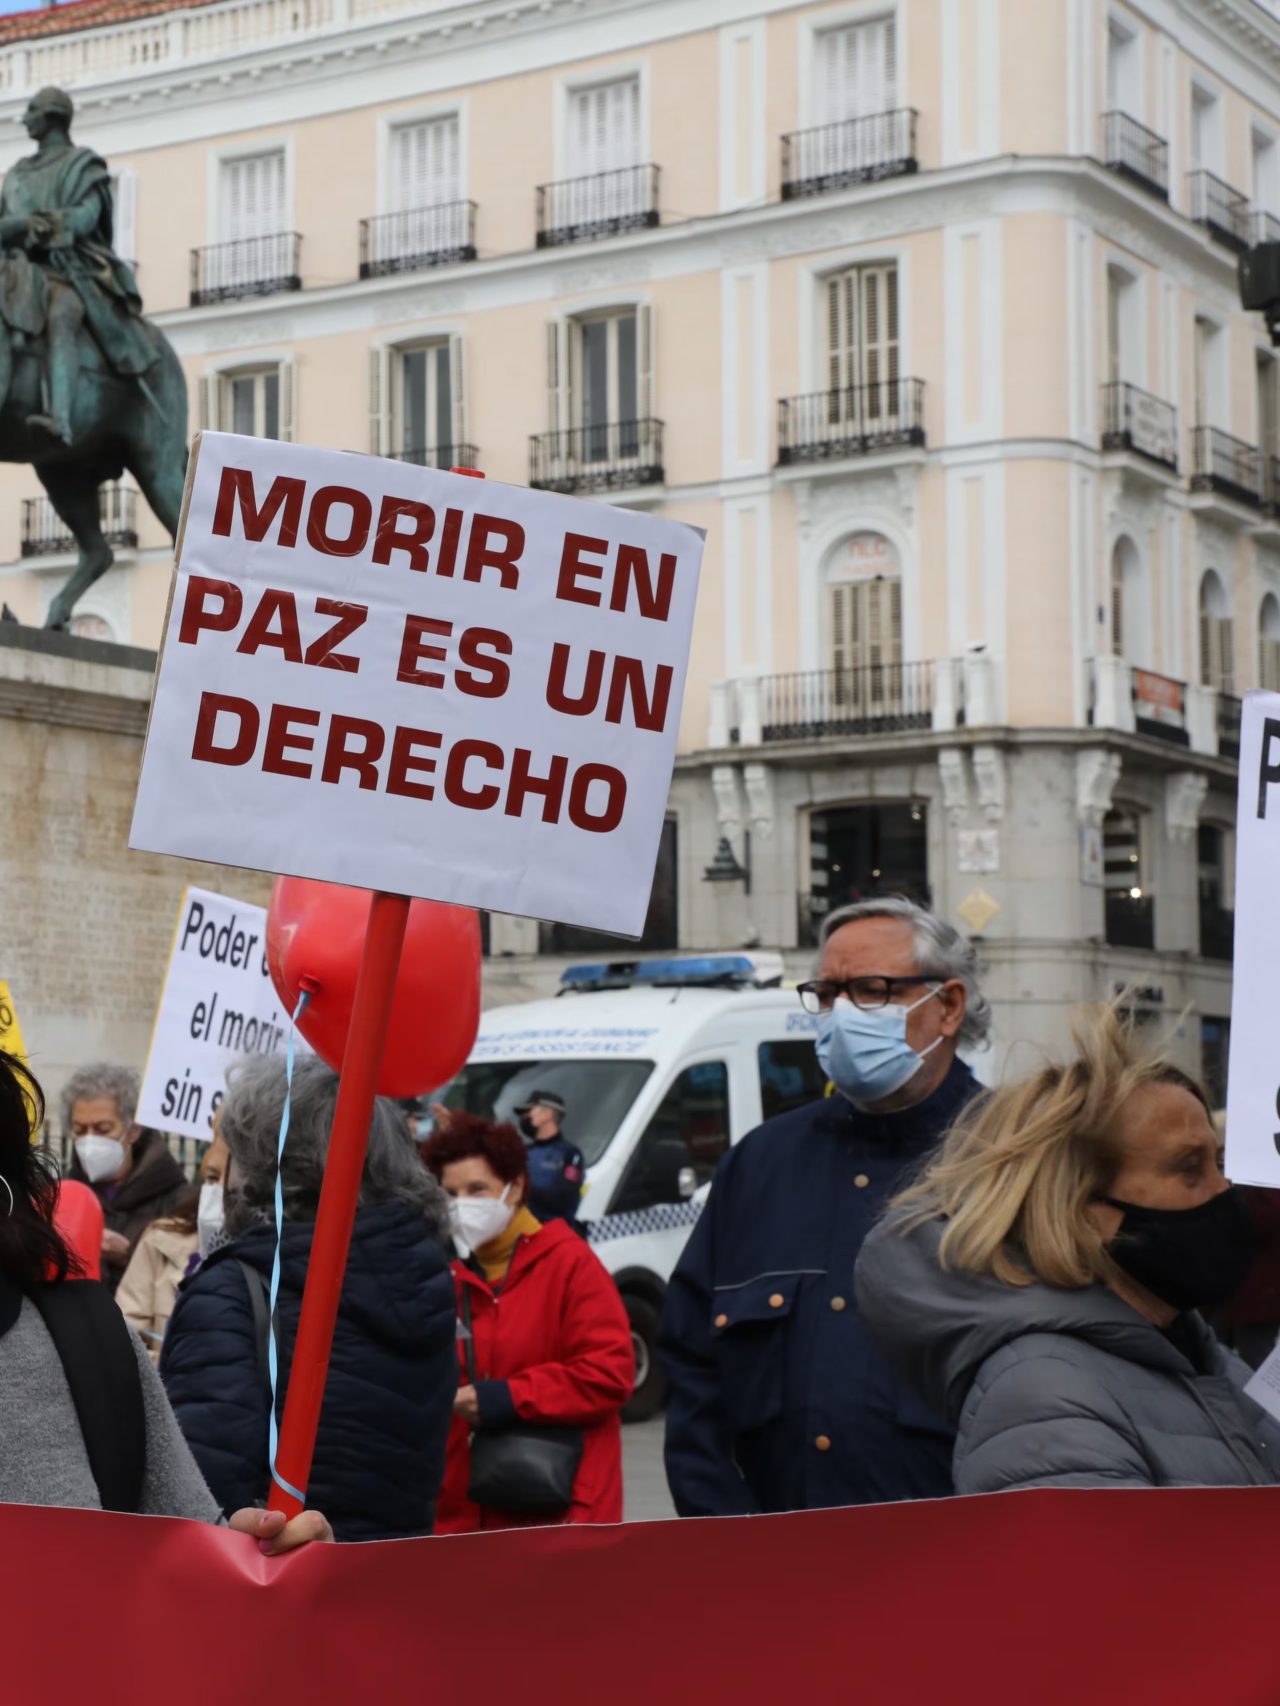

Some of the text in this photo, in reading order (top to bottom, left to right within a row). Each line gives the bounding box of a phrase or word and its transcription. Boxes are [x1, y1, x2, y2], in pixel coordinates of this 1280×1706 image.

[210, 466, 678, 622] MORIR EN
[177, 574, 674, 734] PAZ ES UN
[190, 690, 628, 834] DERECHO
[180, 901, 258, 970] Poder
[190, 991, 286, 1054] el morir
[160, 1067, 203, 1123] sin
